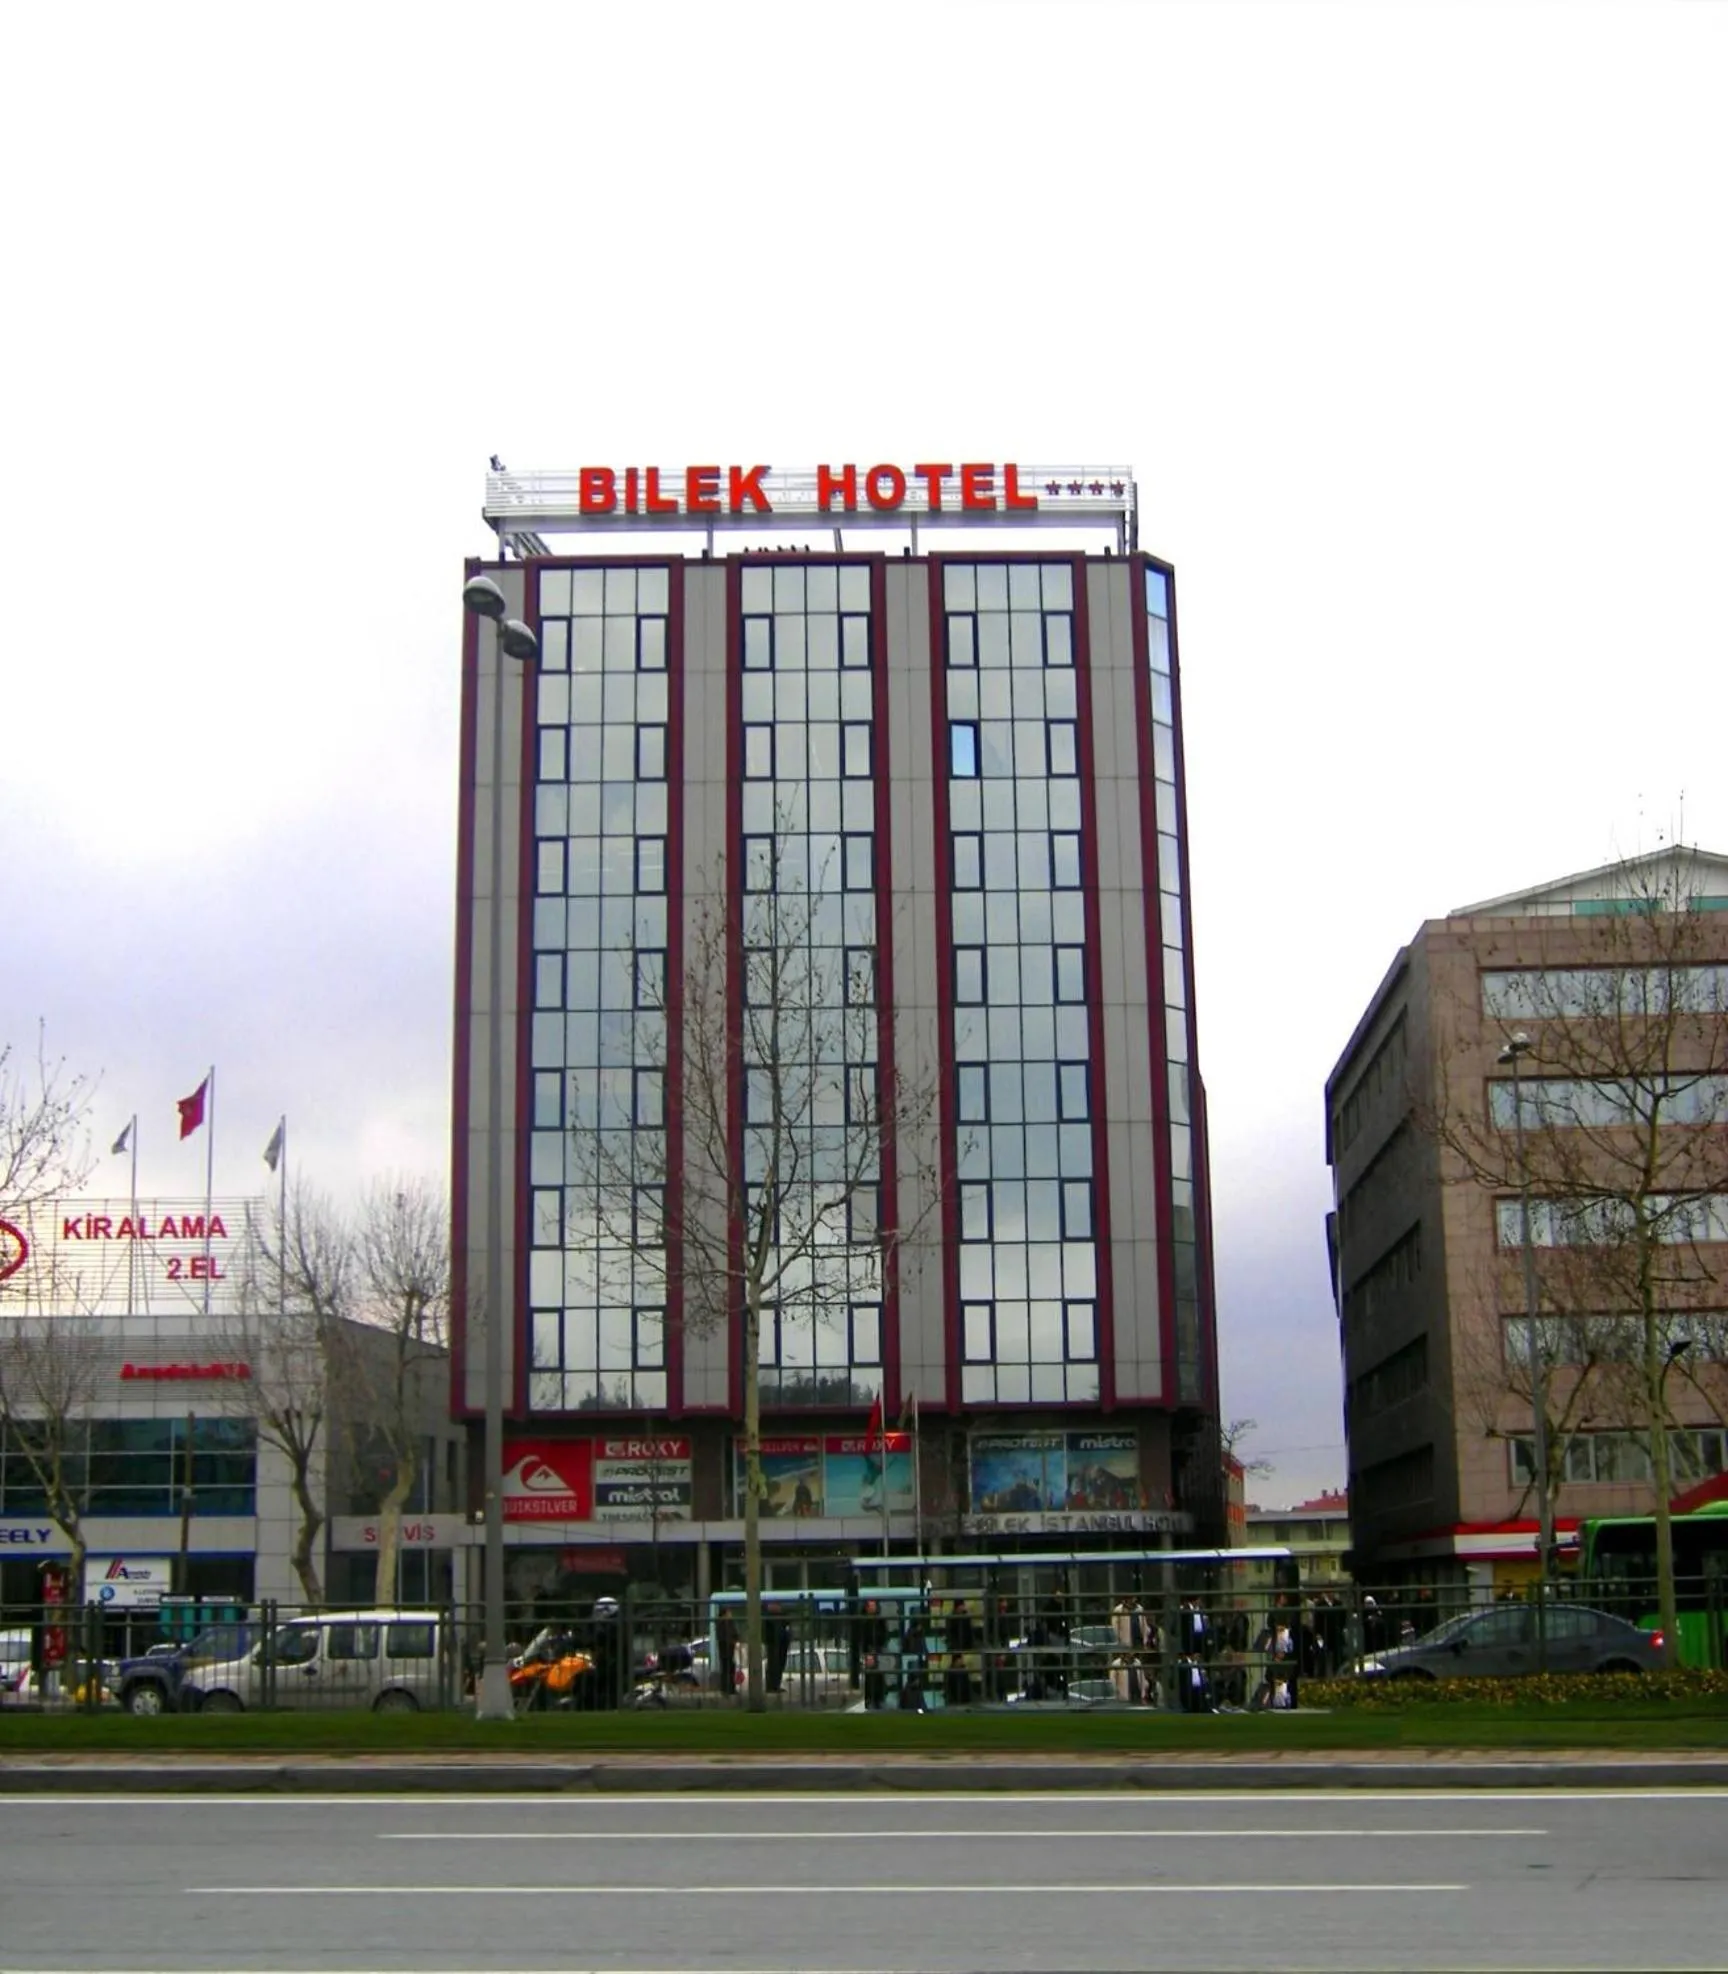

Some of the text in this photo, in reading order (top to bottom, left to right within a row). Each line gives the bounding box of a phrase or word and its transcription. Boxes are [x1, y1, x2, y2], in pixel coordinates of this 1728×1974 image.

[817, 462, 1039, 512] HOTEL
[63, 1212, 227, 1240] KİRALAMA
[166, 1256, 226, 1280] 2.EL
[364, 1522, 435, 1542] SVİS
